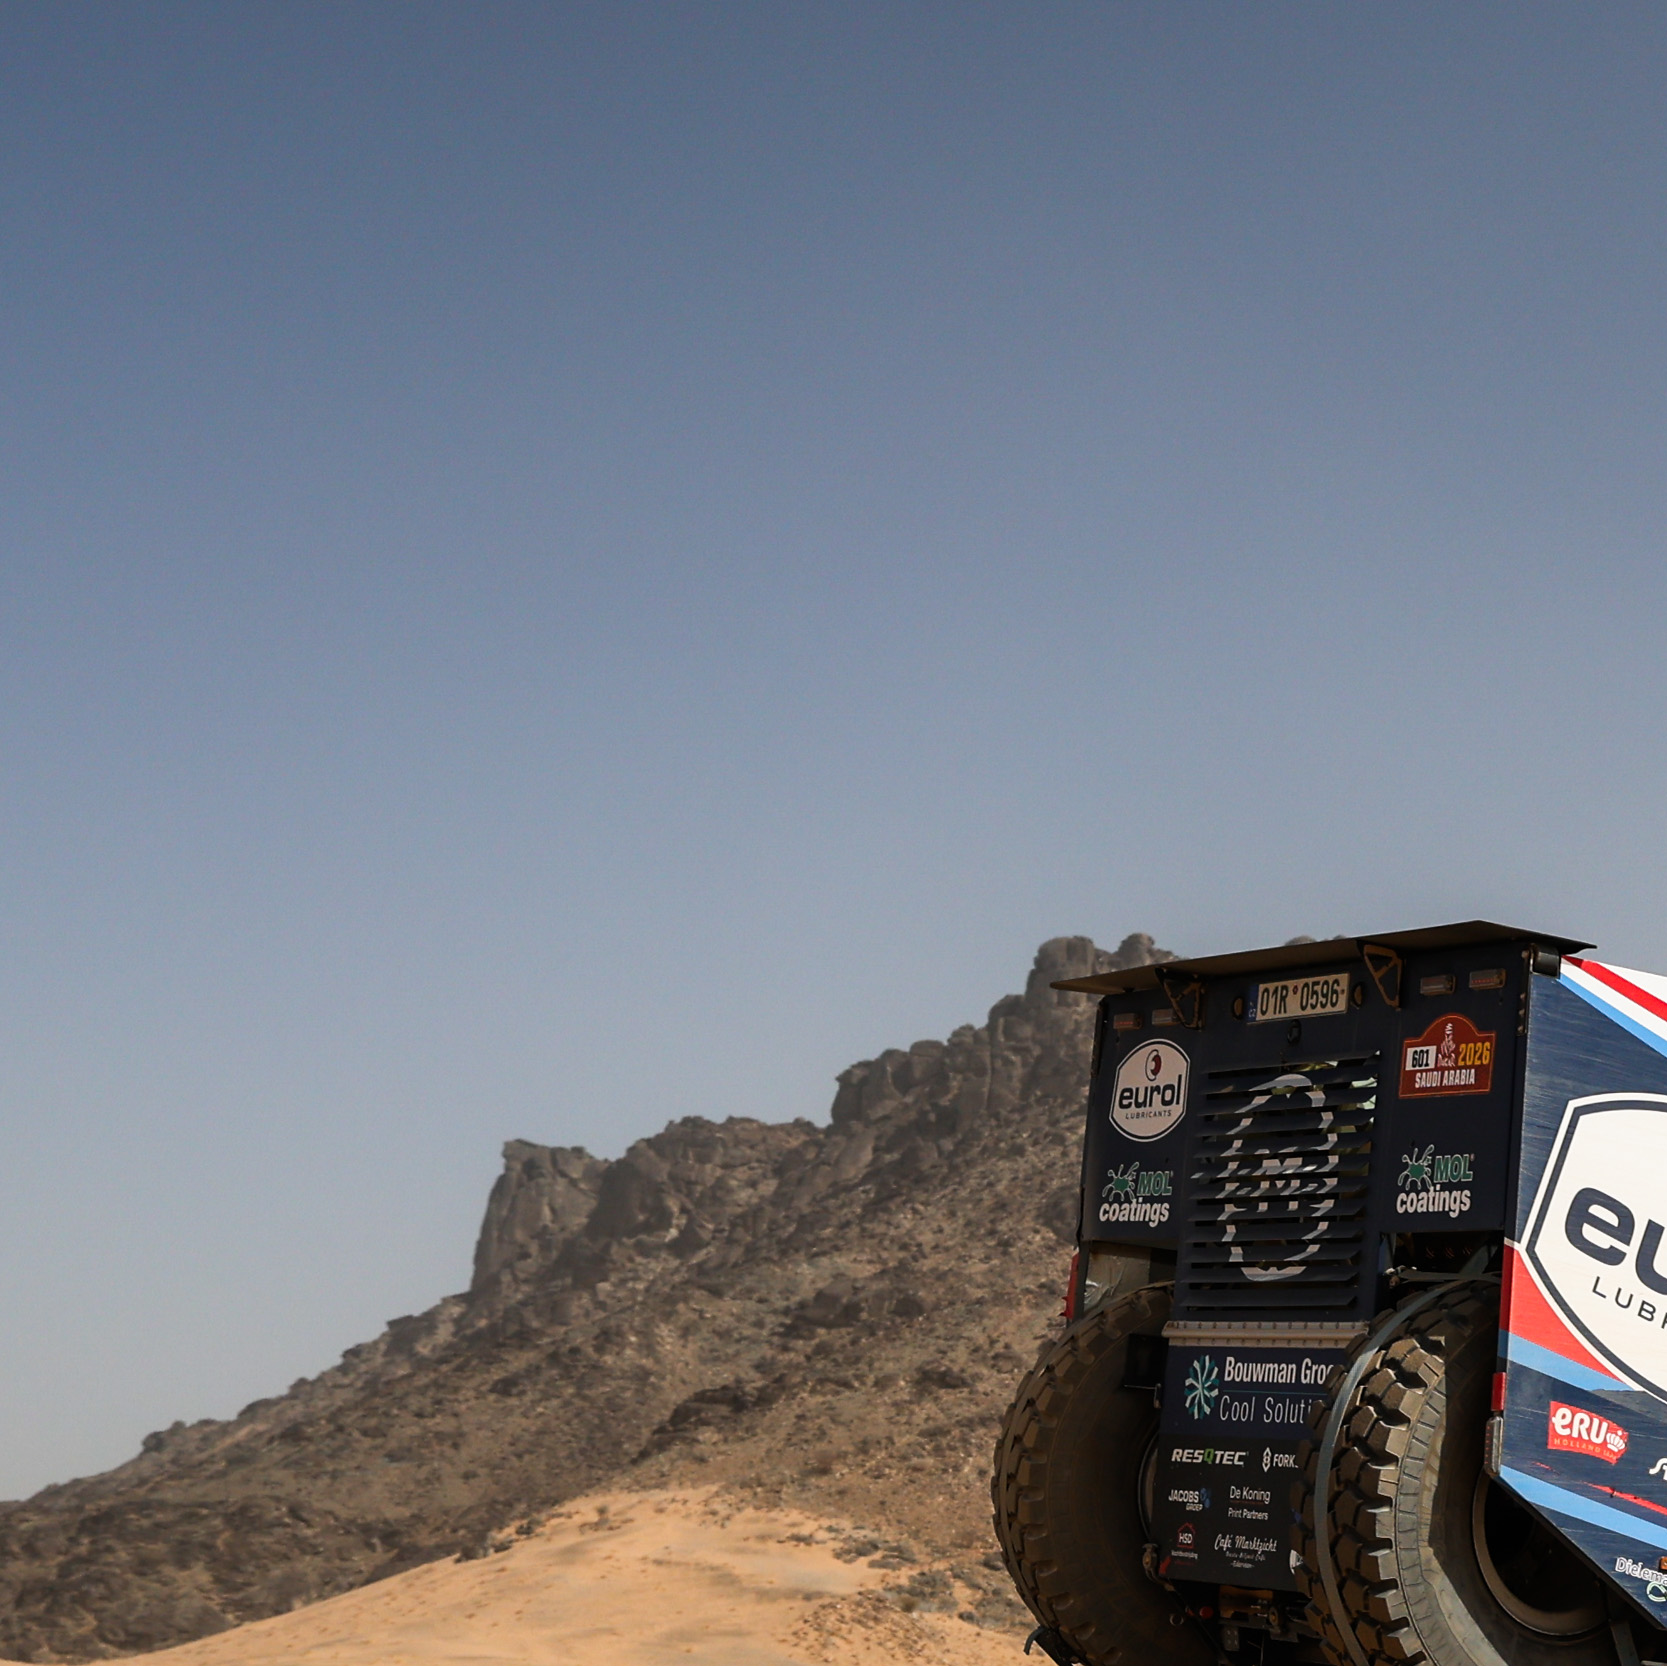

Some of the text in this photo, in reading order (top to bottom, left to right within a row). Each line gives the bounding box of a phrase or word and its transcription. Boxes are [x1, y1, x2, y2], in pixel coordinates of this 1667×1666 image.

[1301, 979, 1340, 1011] 0596
[1412, 1042, 1491, 1068] 601 2026
[1415, 1068, 1476, 1088] SAUDI ARABIA
[1118, 1074, 1182, 1110] eurol
[1125, 1109, 1172, 1120] LUBRICANTS
[1434, 1154, 1473, 1183] MOL
[1137, 1171, 1173, 1196] MOL
[1396, 1184, 1471, 1218] coatings
[1099, 1197, 1170, 1228] coatings
[1224, 1356, 1297, 1384] Bouwman
[1219, 1395, 1255, 1422] Cool
[1554, 1438, 1601, 1452] HOLLAND
[1171, 1448, 1246, 1466] RESQTEC
[1168, 1489, 1200, 1503] JACOBS
[1229, 1486, 1270, 1504] De Koning
[1185, 1503, 1204, 1511] GROEP
[1228, 1508, 1268, 1520] Print Partners
[1179, 1533, 1193, 1544] HSD
[1214, 1534, 1232, 1550] Café
